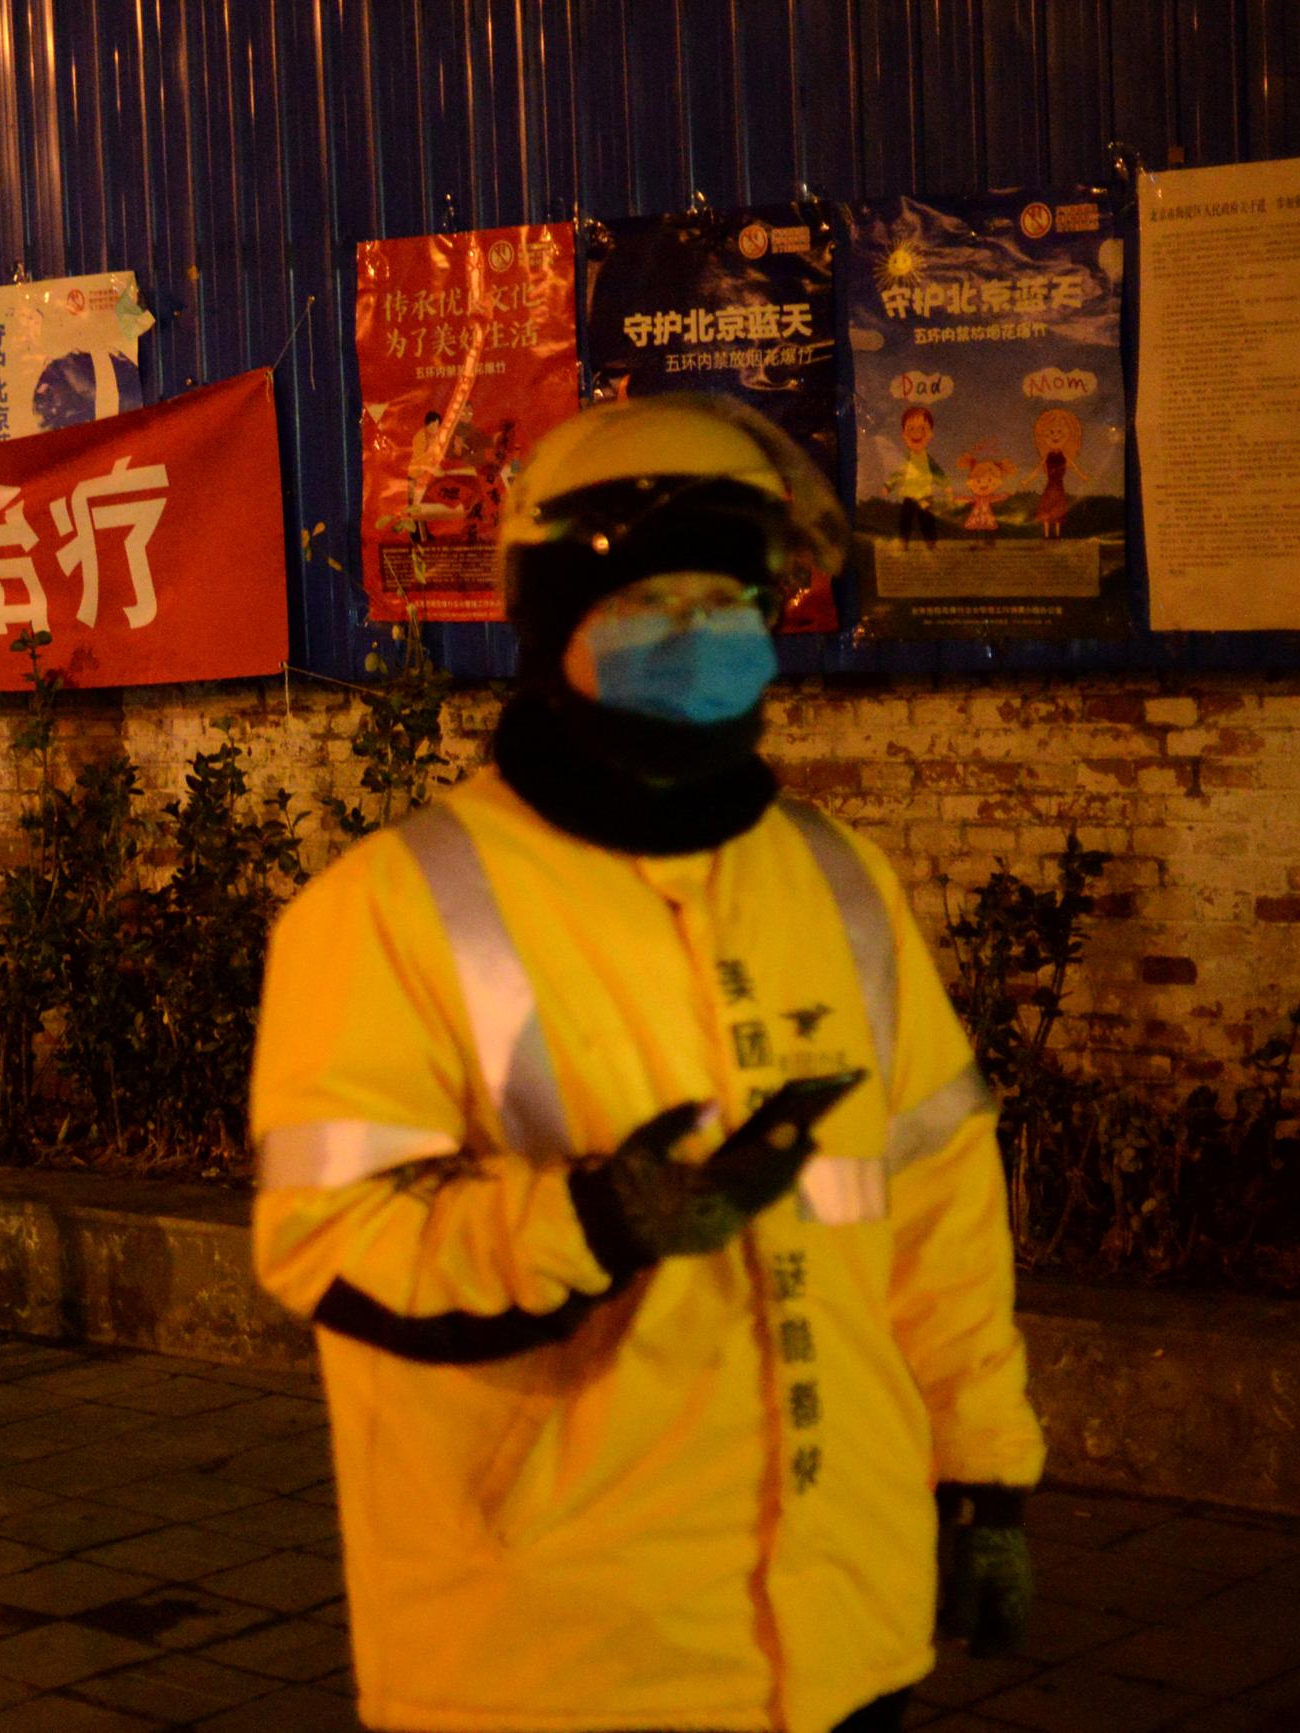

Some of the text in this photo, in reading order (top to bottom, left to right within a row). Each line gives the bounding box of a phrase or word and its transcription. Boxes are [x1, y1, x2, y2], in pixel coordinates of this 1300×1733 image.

[623, 303, 813, 347] 守护北京蓝天
[665, 348, 813, 373] 五环内禁放烟花爆竹
[901, 374, 1088, 398] Dad Mom
